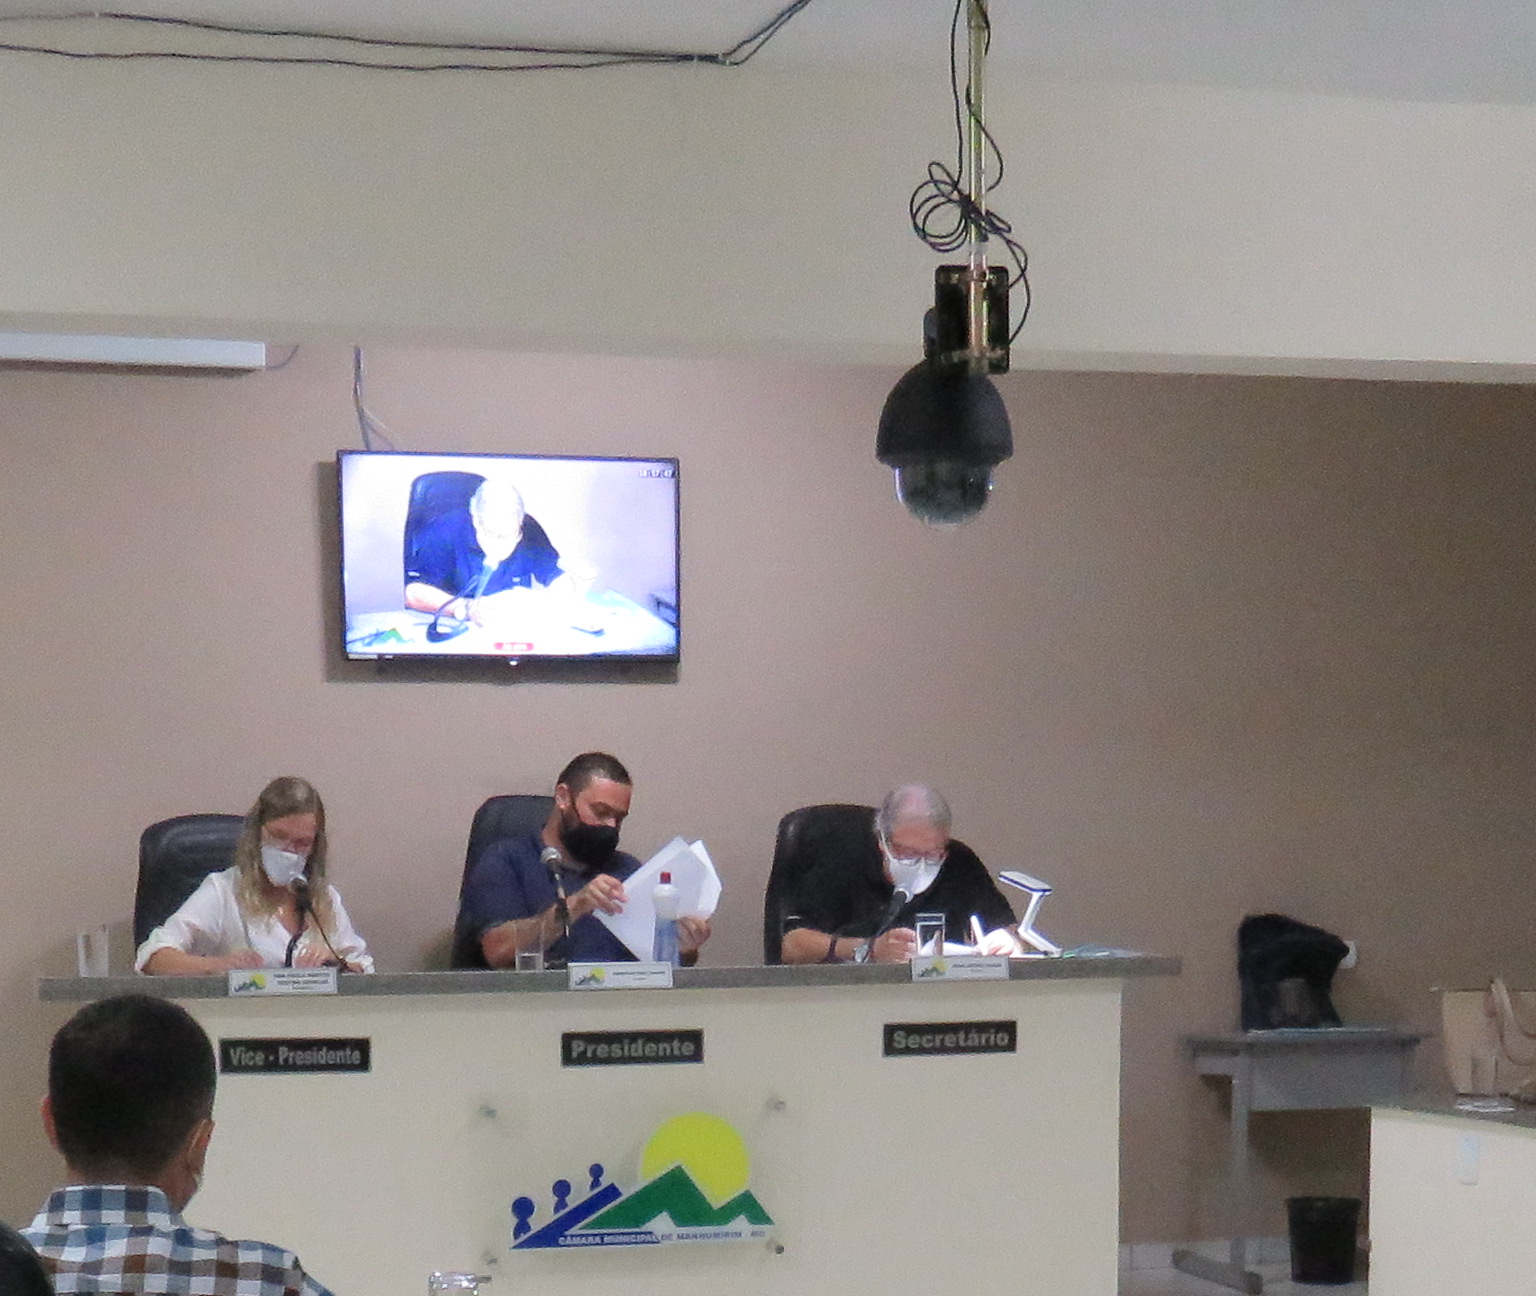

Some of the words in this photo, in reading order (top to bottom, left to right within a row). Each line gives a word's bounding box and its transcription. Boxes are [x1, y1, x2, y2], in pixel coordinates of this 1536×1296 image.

[571, 1038, 696, 1058] Presidente
[893, 1028, 1010, 1049] Secretário
[230, 1046, 265, 1066] Vice
[278, 1045, 361, 1066] Presidente
